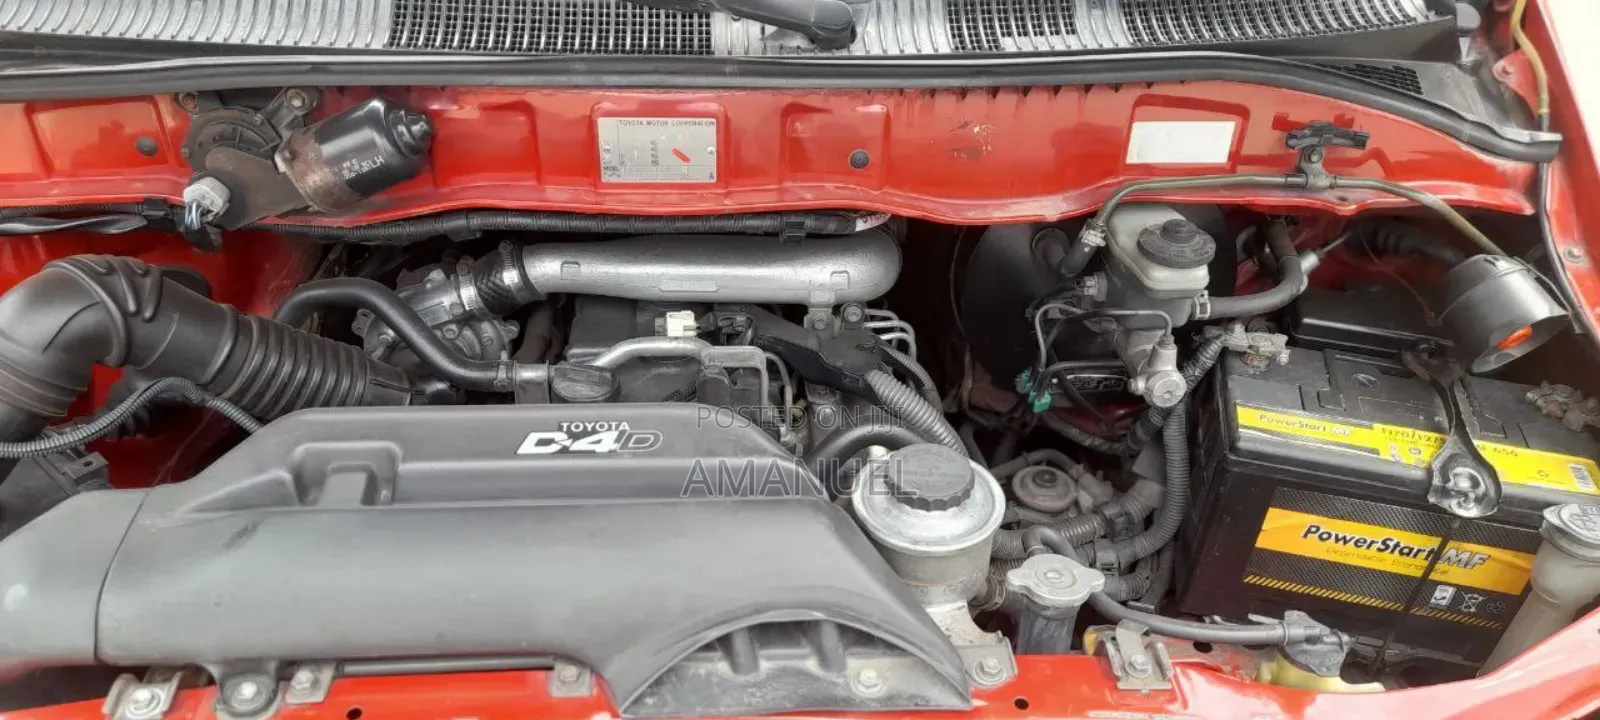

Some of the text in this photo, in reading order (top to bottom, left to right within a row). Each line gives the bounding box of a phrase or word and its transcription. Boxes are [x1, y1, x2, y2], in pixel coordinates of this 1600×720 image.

[672, 119, 715, 127] CORPORATION
[369, 154, 385, 168] LH
[560, 421, 630, 432] TOYOTA
[1259, 413, 1326, 433] PowerStart
[1301, 524, 1491, 570] PowerStart MF
